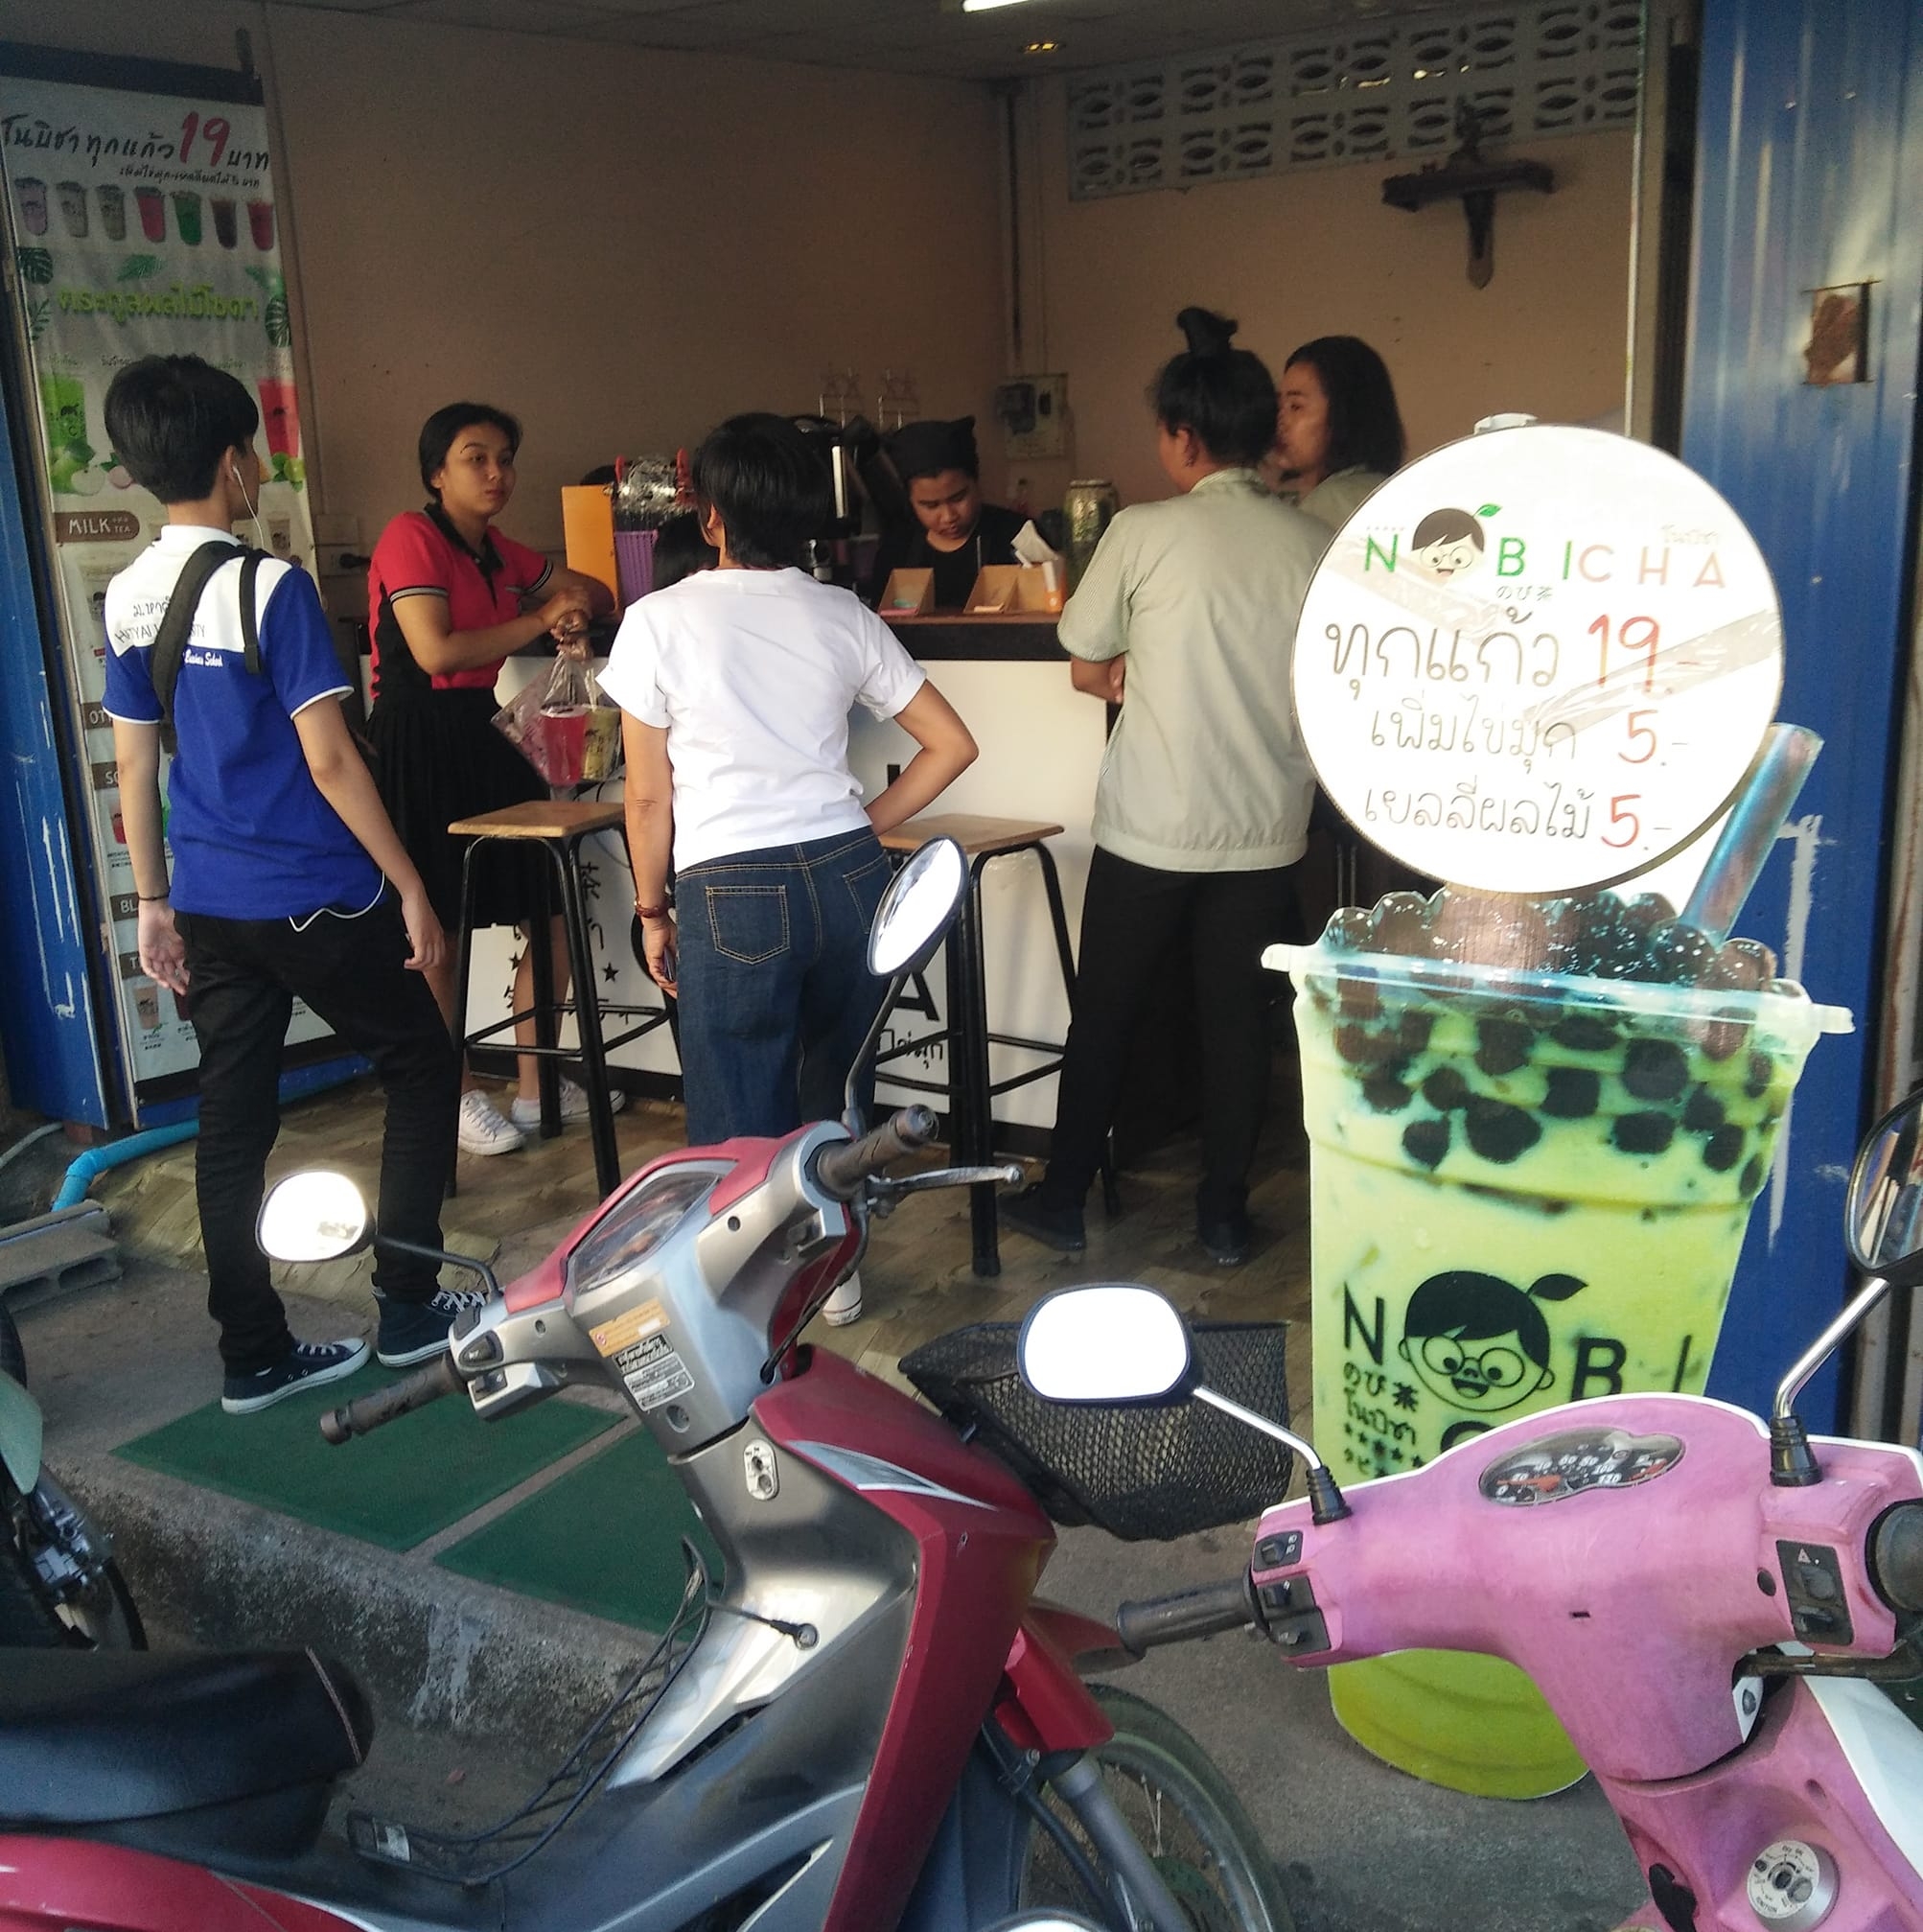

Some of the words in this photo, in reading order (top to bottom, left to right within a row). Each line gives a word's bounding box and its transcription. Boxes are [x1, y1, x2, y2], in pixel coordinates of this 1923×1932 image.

[179, 110, 230, 168] 19
[69, 518, 110, 534] MILK
[1325, 606, 1560, 701] ทุกแก้ว
[120, 899, 139, 915] BL
